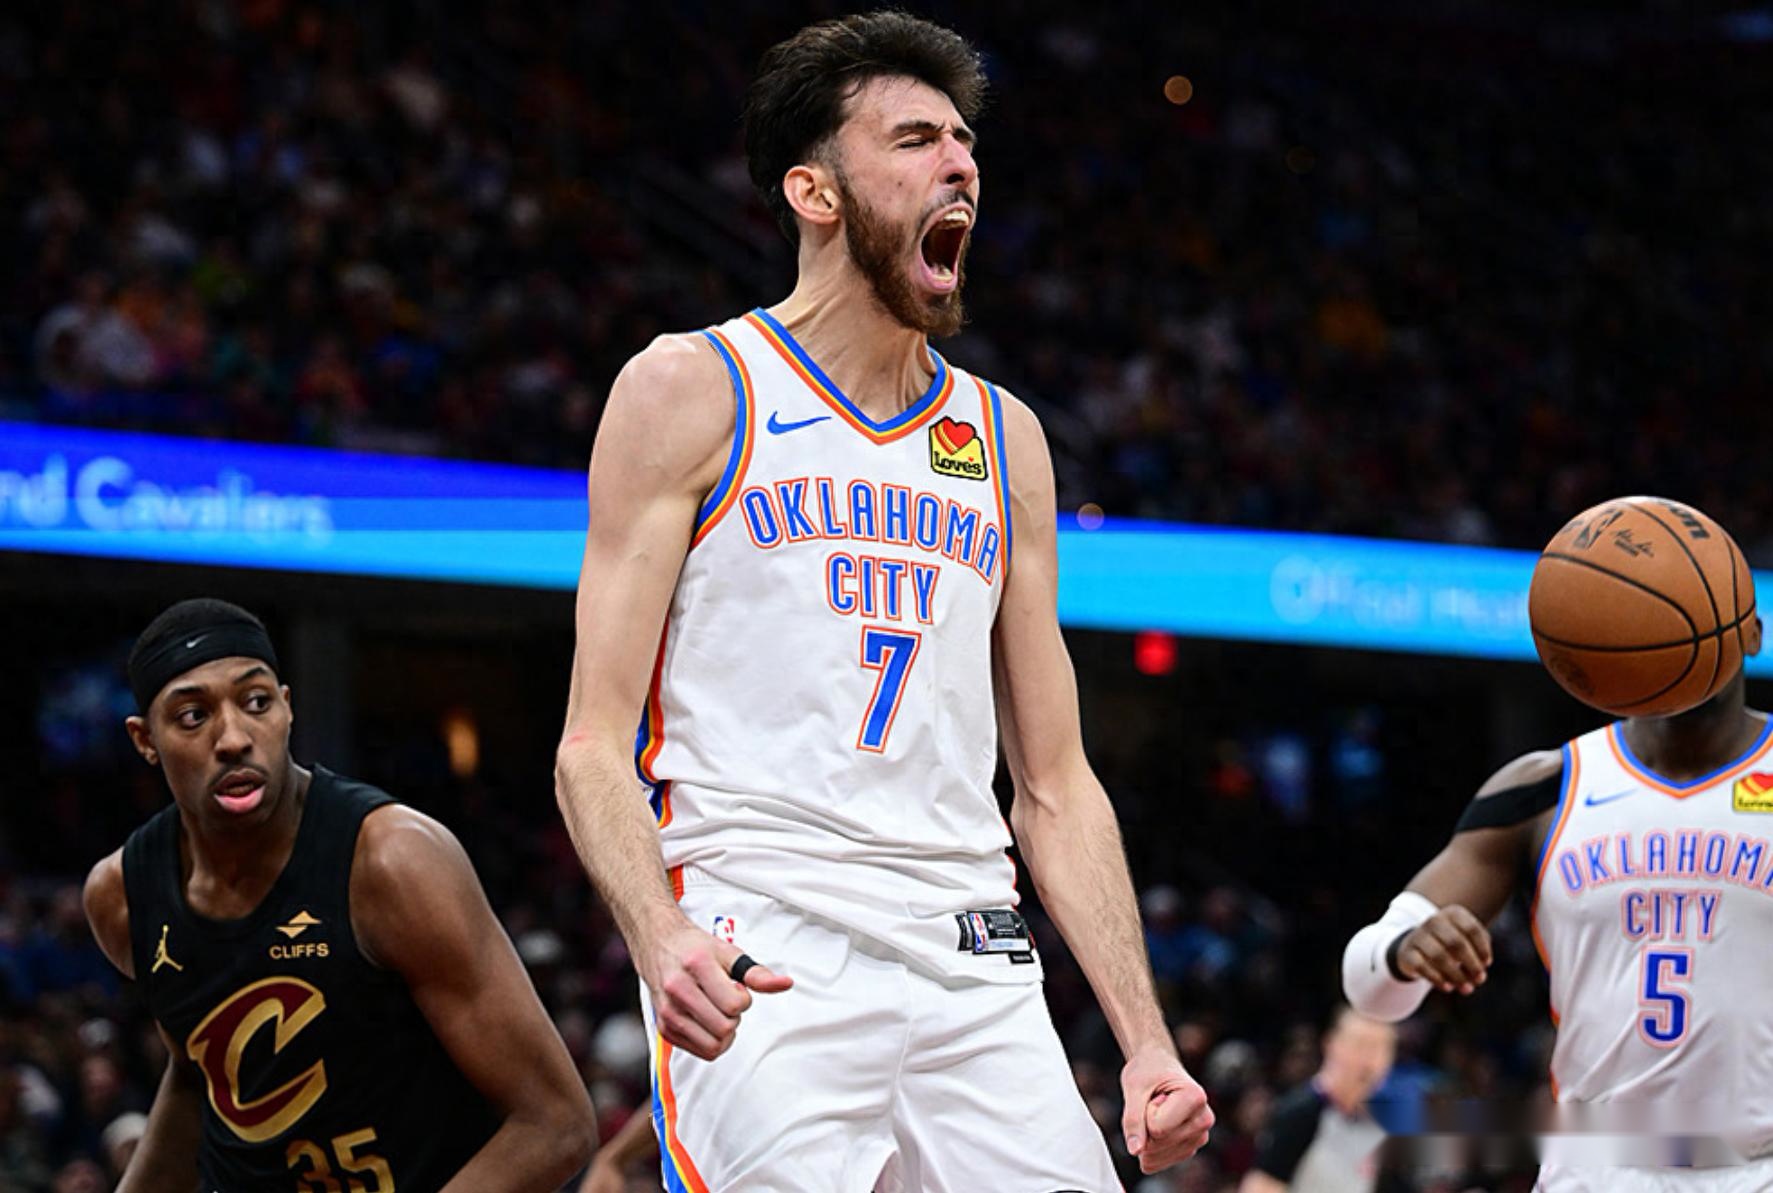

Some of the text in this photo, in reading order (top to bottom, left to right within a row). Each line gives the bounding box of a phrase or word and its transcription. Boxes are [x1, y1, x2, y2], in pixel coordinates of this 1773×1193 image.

[740, 477, 1001, 586] OKLAHOMA
[826, 551, 941, 625] CITY
[856, 624, 922, 753] 7
[269, 942, 330, 960] CLIFFS
[1621, 888, 1723, 942] CITY
[1637, 944, 1694, 1049] 5
[186, 976, 328, 1143] C
[287, 1126, 396, 1193] 35
